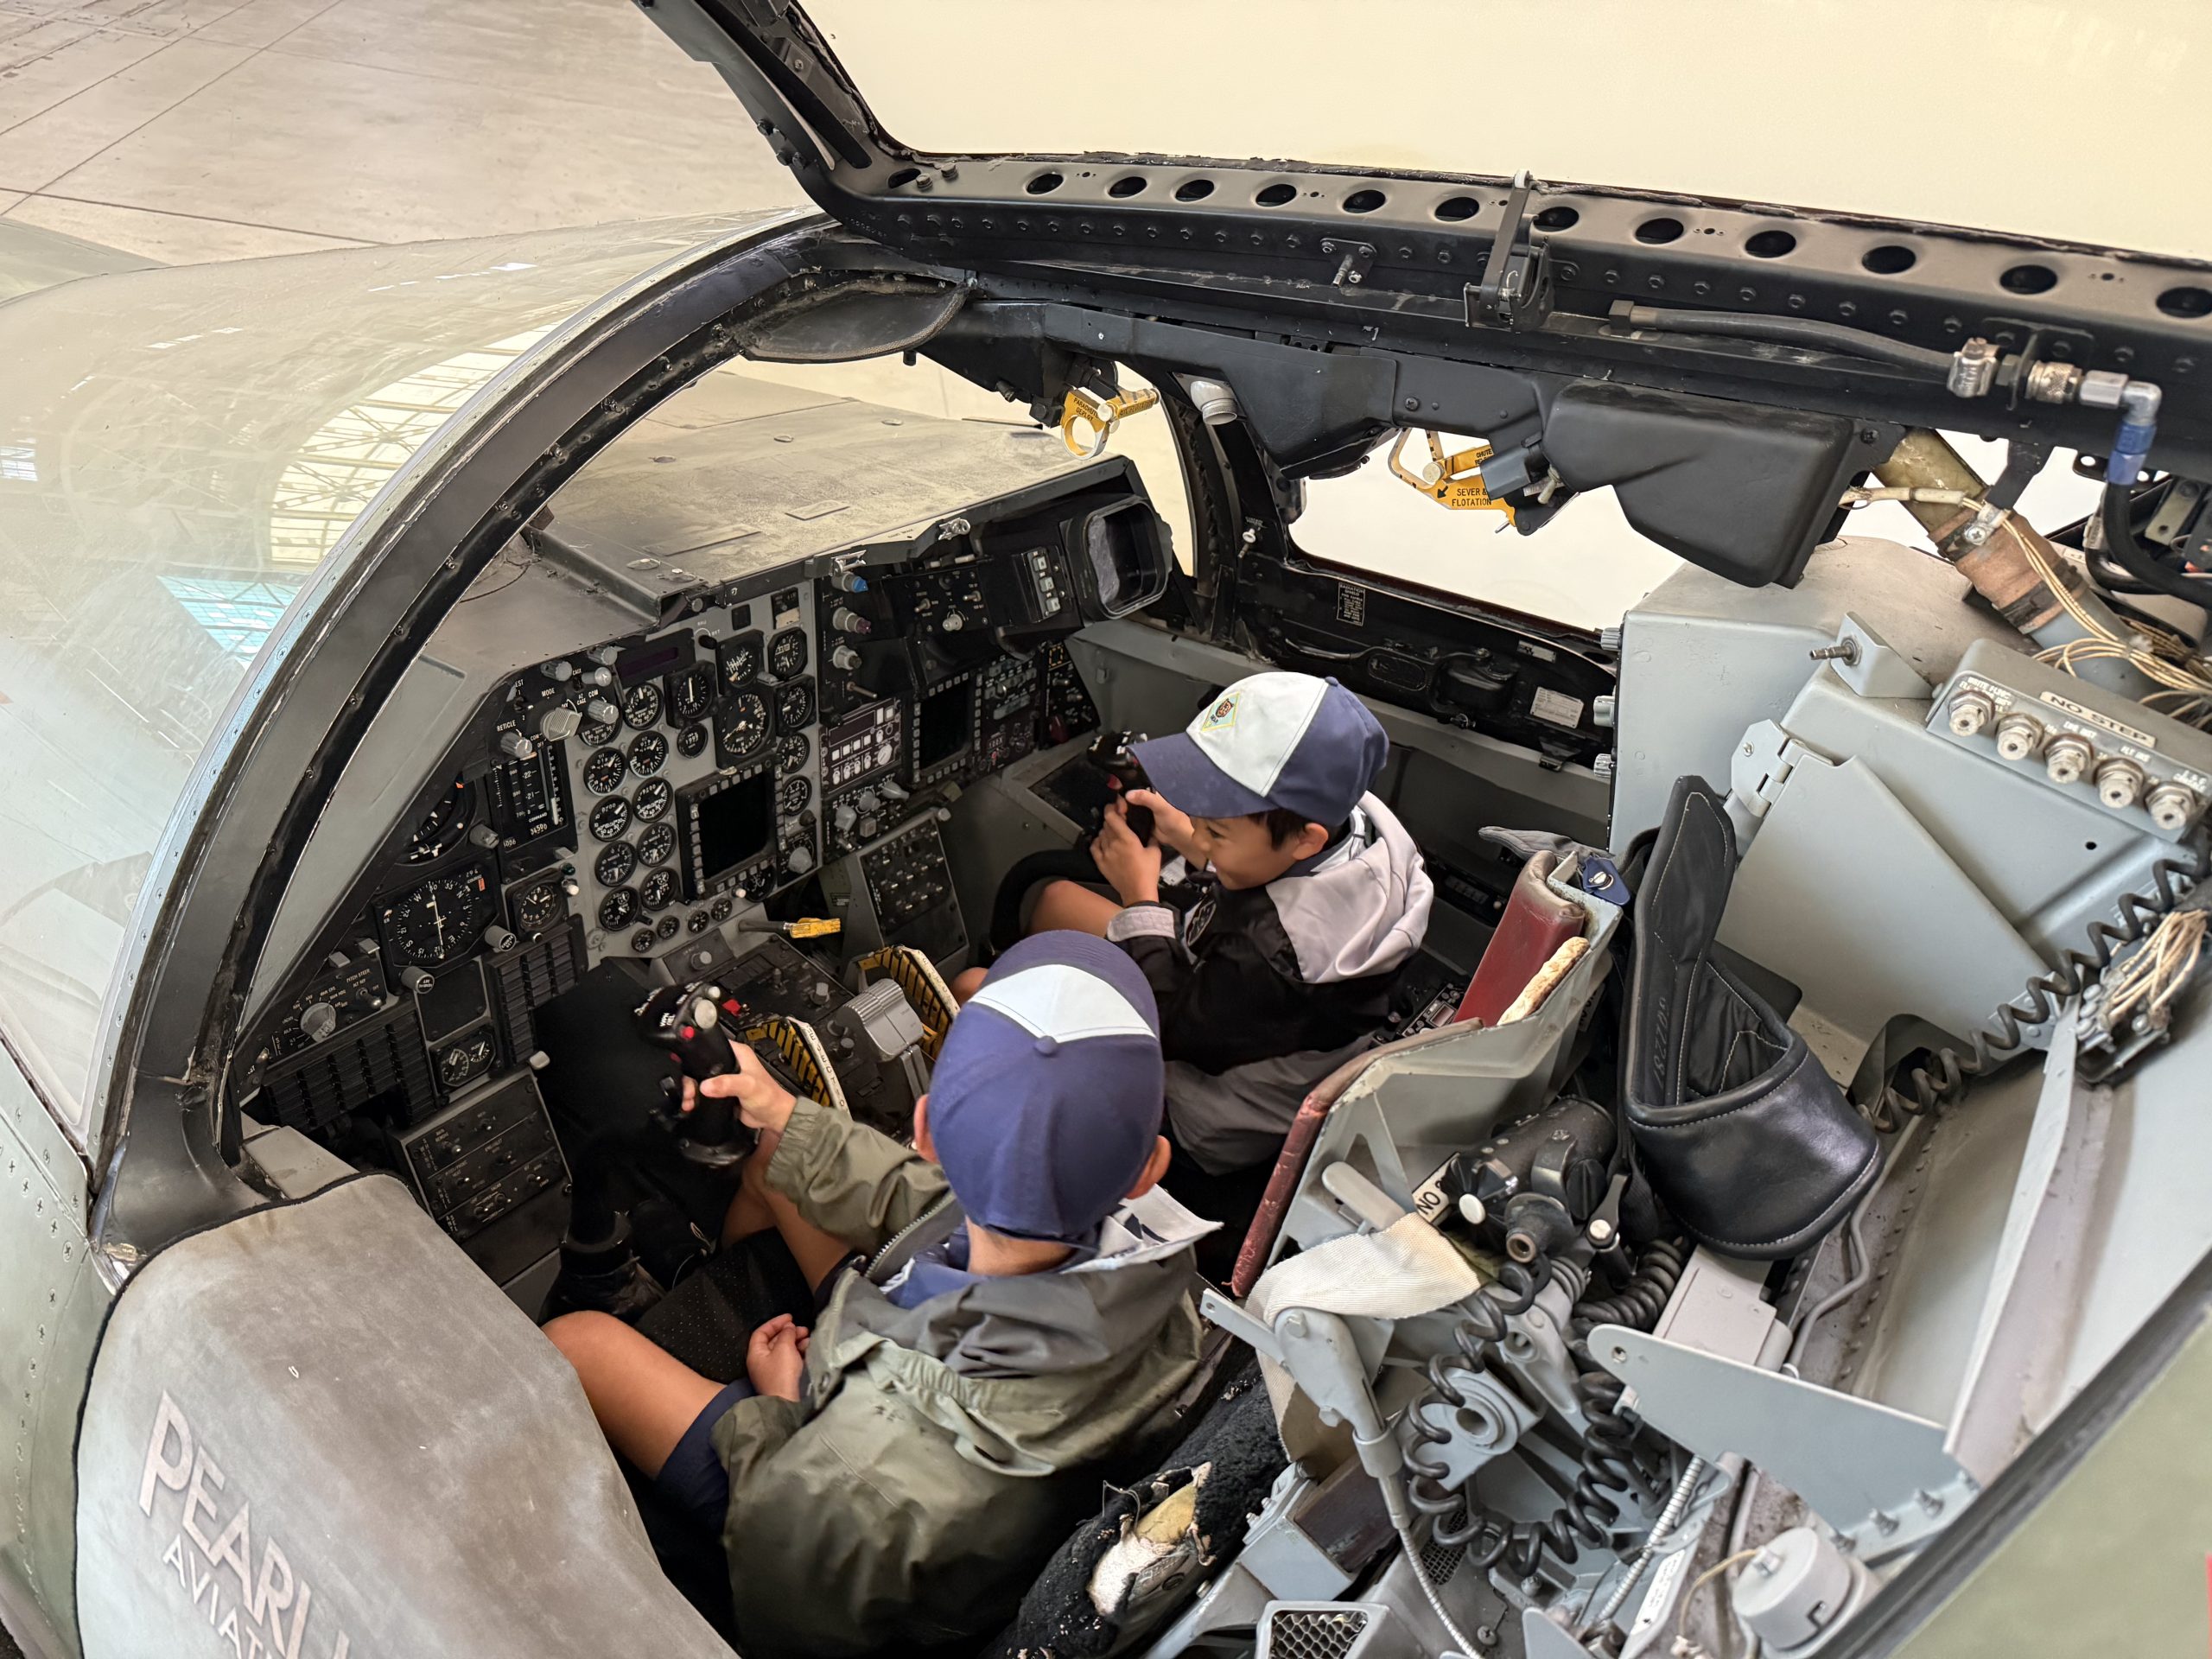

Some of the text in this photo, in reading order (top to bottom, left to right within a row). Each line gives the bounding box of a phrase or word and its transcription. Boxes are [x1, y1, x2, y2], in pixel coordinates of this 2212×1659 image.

[1076, 408, 1094, 422] DEPLOY
[1476, 448, 1493, 458] CHUTE
[1457, 487, 1489, 497] SEVER &
[1452, 498, 1492, 507] FLOTATION
[541, 687, 556, 697] MODE
[588, 690, 599, 699] COM
[2050, 695, 2148, 741] NO STEP
[496, 720, 517, 732] RETICLE
[1416, 1191, 1441, 1215] NO
[162, 1533, 274, 1659] AVIAT
